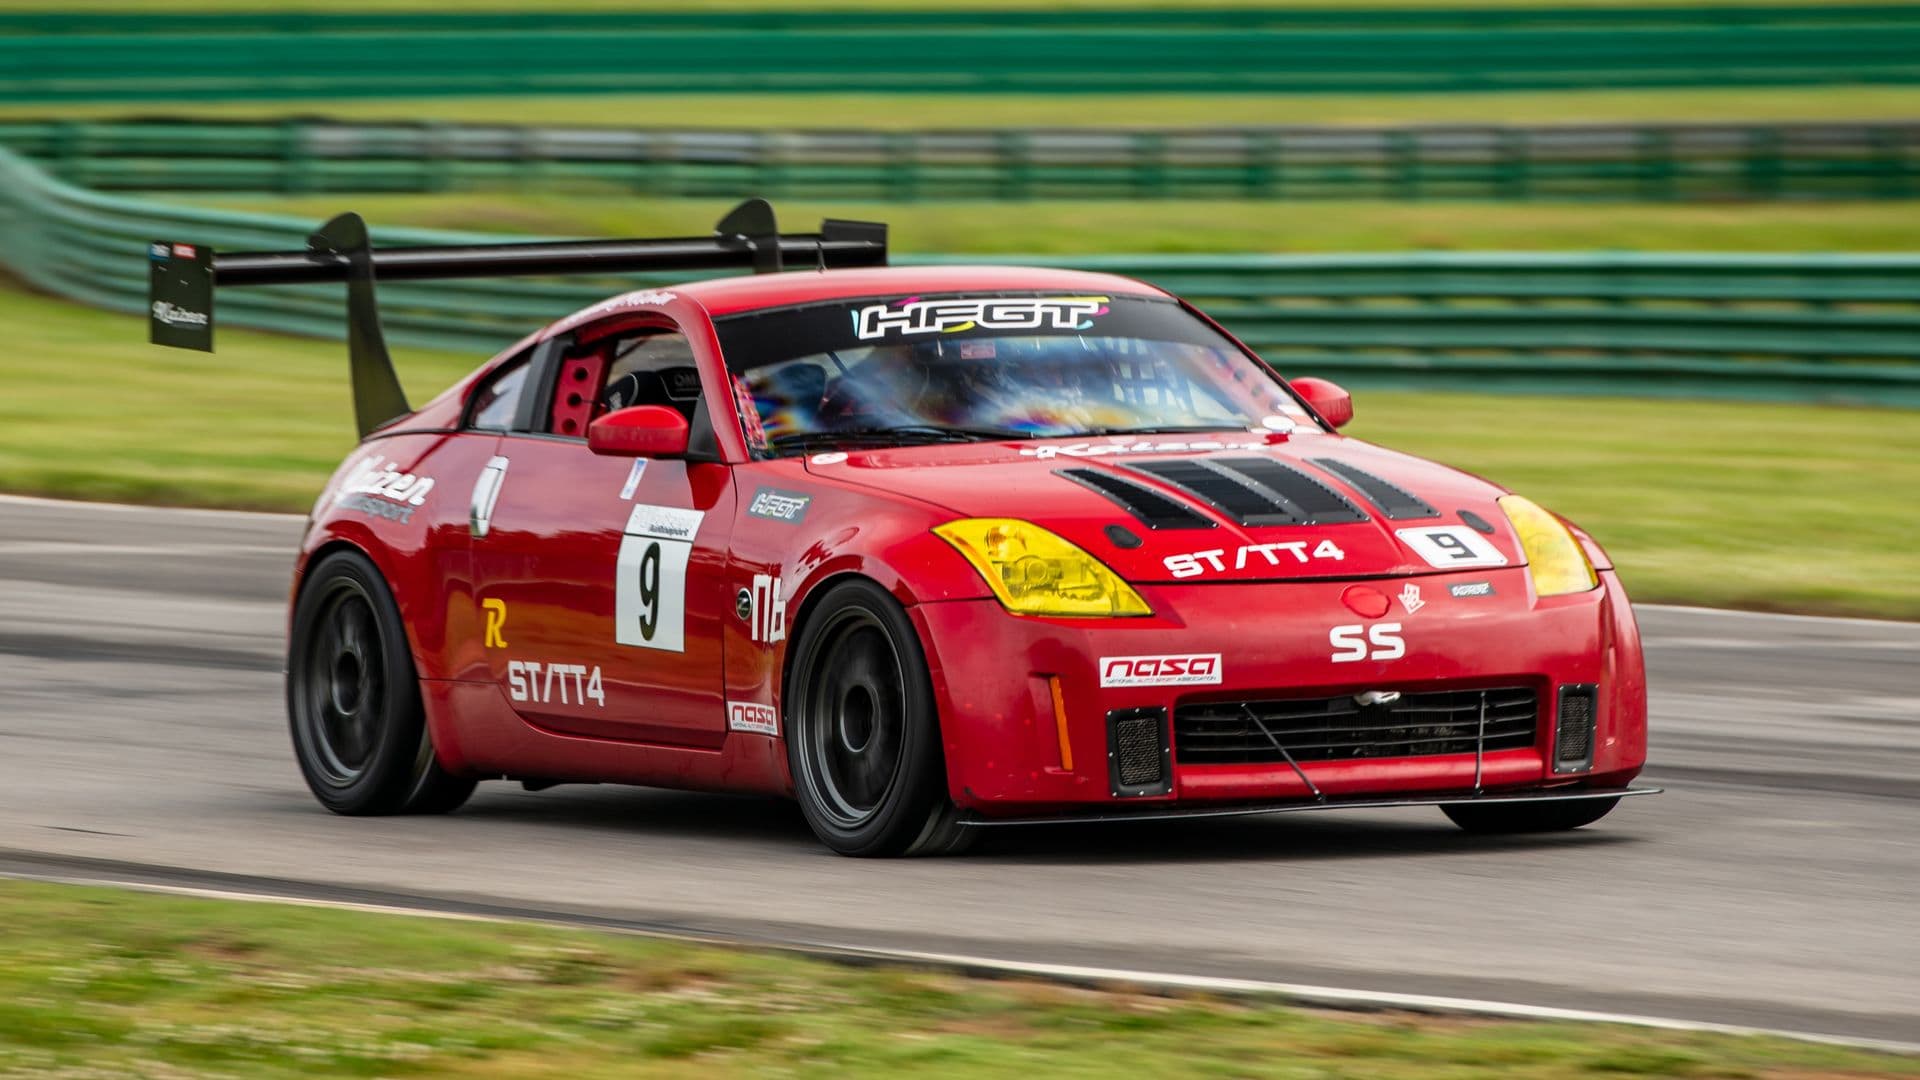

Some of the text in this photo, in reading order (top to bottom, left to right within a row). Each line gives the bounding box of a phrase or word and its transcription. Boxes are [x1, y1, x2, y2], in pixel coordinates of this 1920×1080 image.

[858, 297, 1099, 340] HFGT
[750, 493, 809, 520] HFGT
[1163, 539, 1345, 578] ST/TT4
[1426, 533, 1477, 559] 9
[639, 541, 661, 642] 9
[482, 598, 508, 648] R
[1329, 622, 1405, 663] SS
[508, 660, 605, 707] ST/TT4
